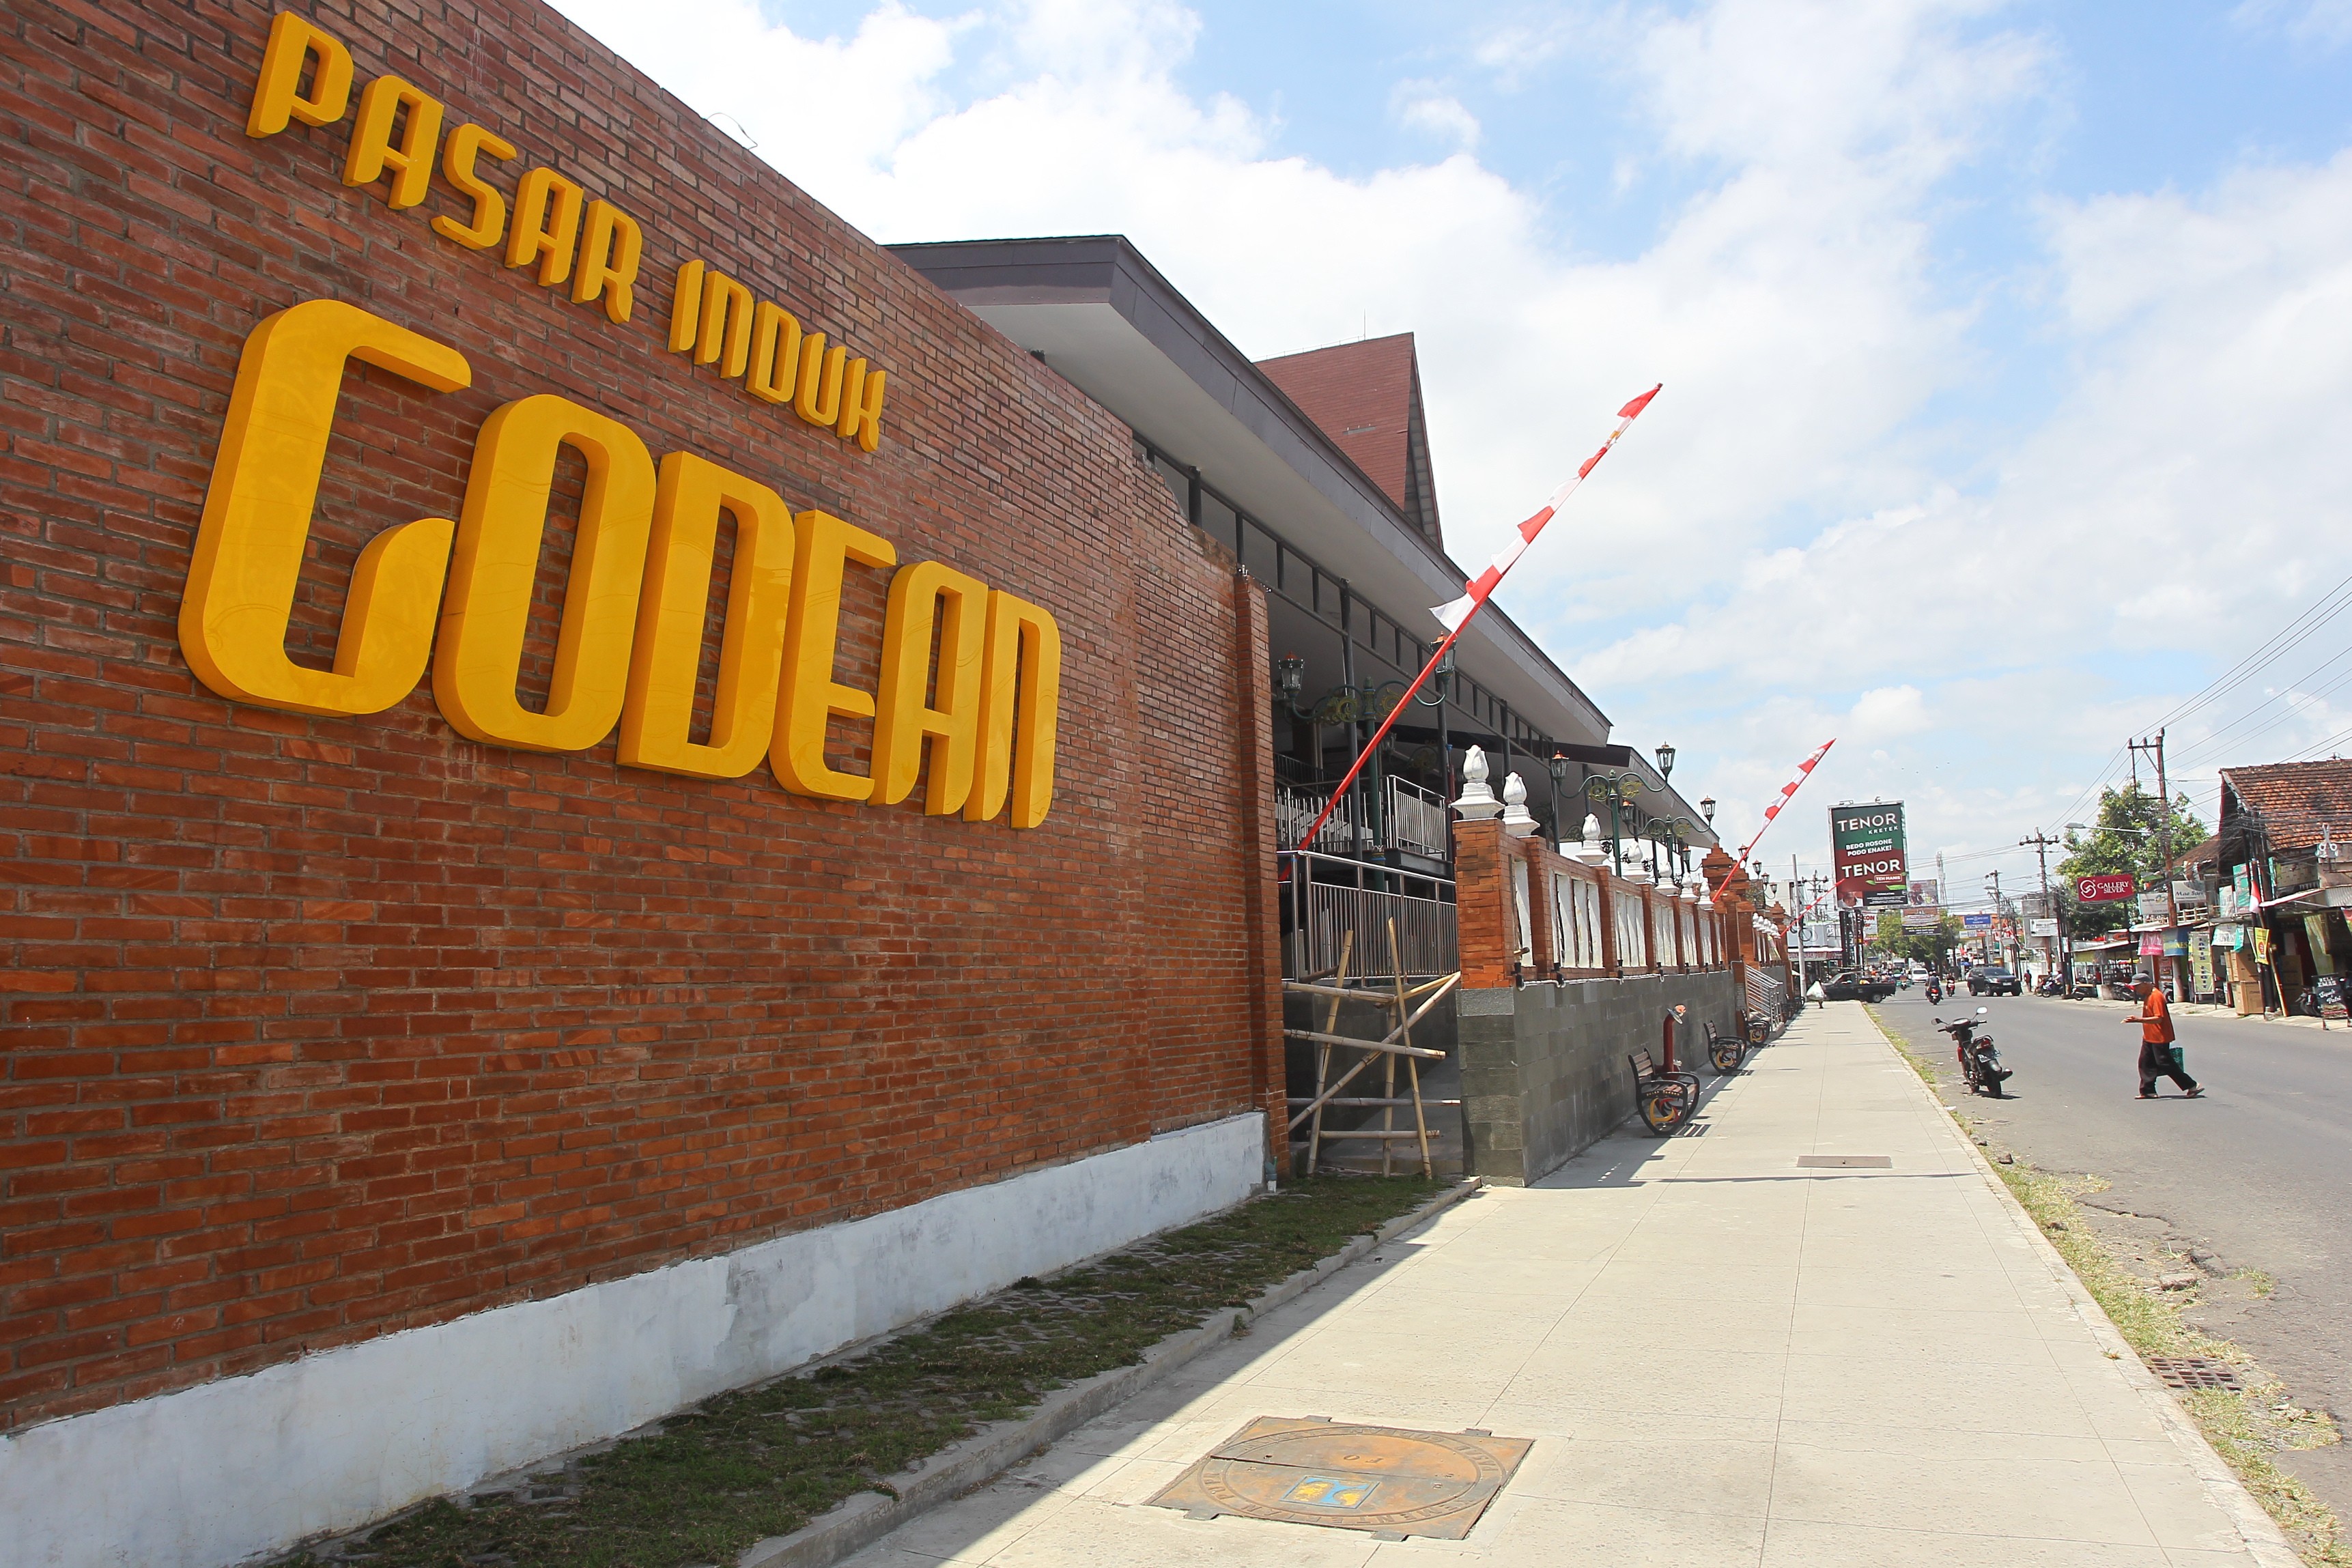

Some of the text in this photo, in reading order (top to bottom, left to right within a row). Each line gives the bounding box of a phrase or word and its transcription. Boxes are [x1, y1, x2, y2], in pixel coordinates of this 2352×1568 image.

[246, 10, 885, 453] PASAR INDUK
[178, 299, 1062, 829] GODEAN
[1837, 812, 1897, 832] TENOR
[1868, 825, 1898, 835] KRETEK
[1845, 838, 1893, 851] BEDO ROSONE
[1847, 844, 1892, 857] PODO ENAKE!
[1841, 859, 1901, 878] TENOR
[2097, 881, 2129, 889] GALLERY
